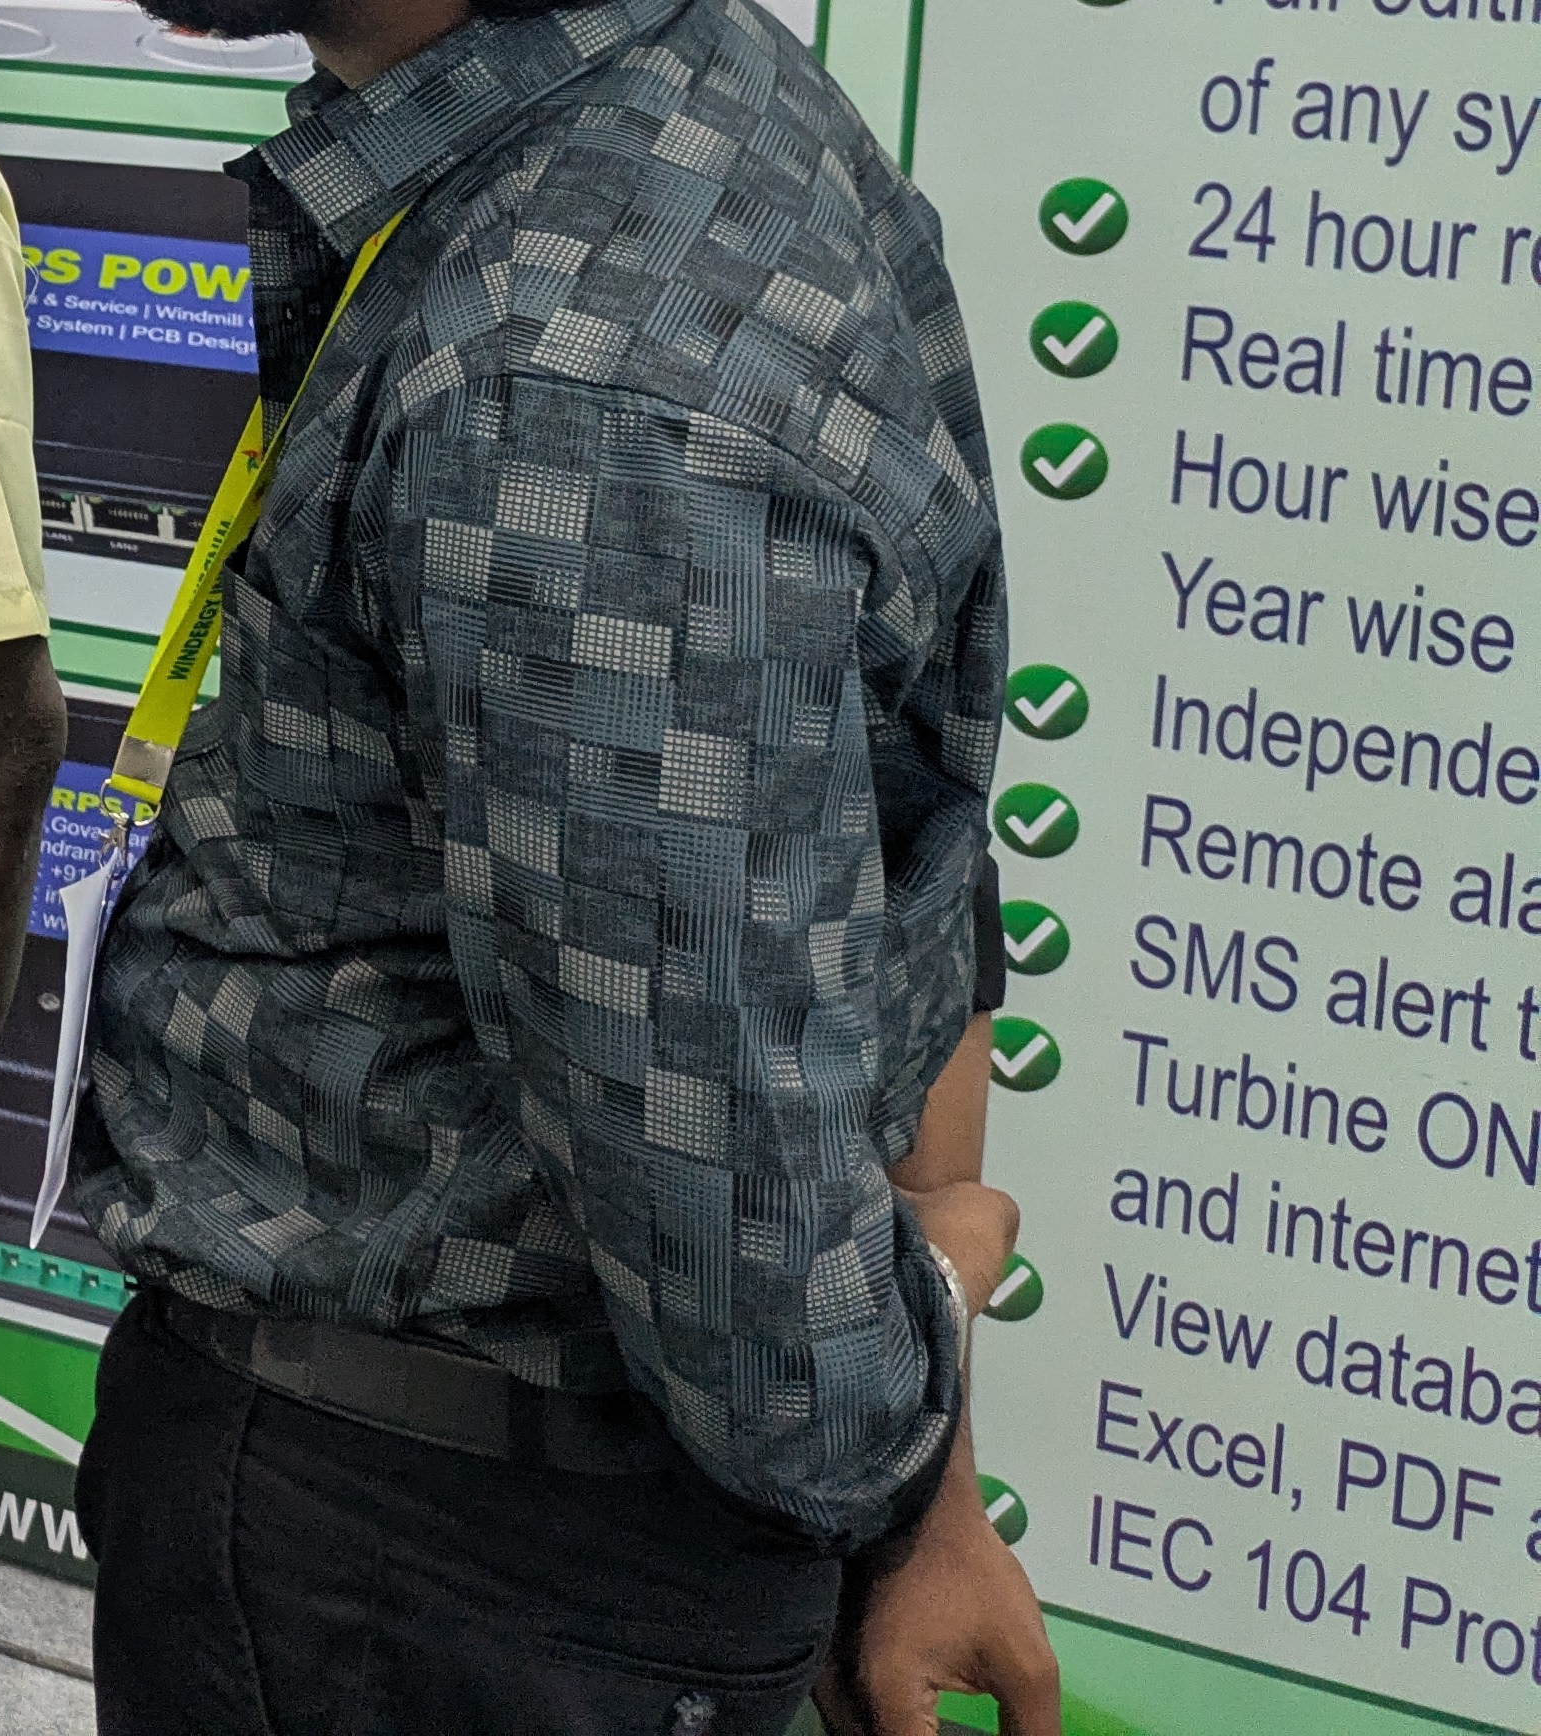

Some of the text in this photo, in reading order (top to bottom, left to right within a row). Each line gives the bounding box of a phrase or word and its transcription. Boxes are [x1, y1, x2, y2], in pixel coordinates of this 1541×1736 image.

[1200, 57, 1275, 136] of
[1291, 79, 1430, 168] any
[1188, 181, 1276, 263] 24
[1304, 190, 1477, 281] hour
[35, 314, 114, 338] System
[131, 325, 181, 345] PCB
[44, 293, 244, 328] & Service Windmill
[1180, 304, 1533, 417] Real time
[1171, 427, 1541, 547] Hour wise
[167, 599, 222, 682] WINDERGY
[1160, 549, 1516, 674] Year wise
[1150, 673, 1540, 805] Independe
[1140, 791, 1422, 914] Remote
[1130, 912, 1492, 1052] SMS alert
[1122, 1029, 1389, 1156] Turbine
[1108, 1166, 1541, 1316] and internet
[1102, 1263, 1274, 1370] View
[1095, 1379, 1304, 1512] Excel,
[1336, 1437, 1503, 1545] PDF
[1088, 1493, 1214, 1594] IEC
[1245, 1537, 1372, 1638] 104
